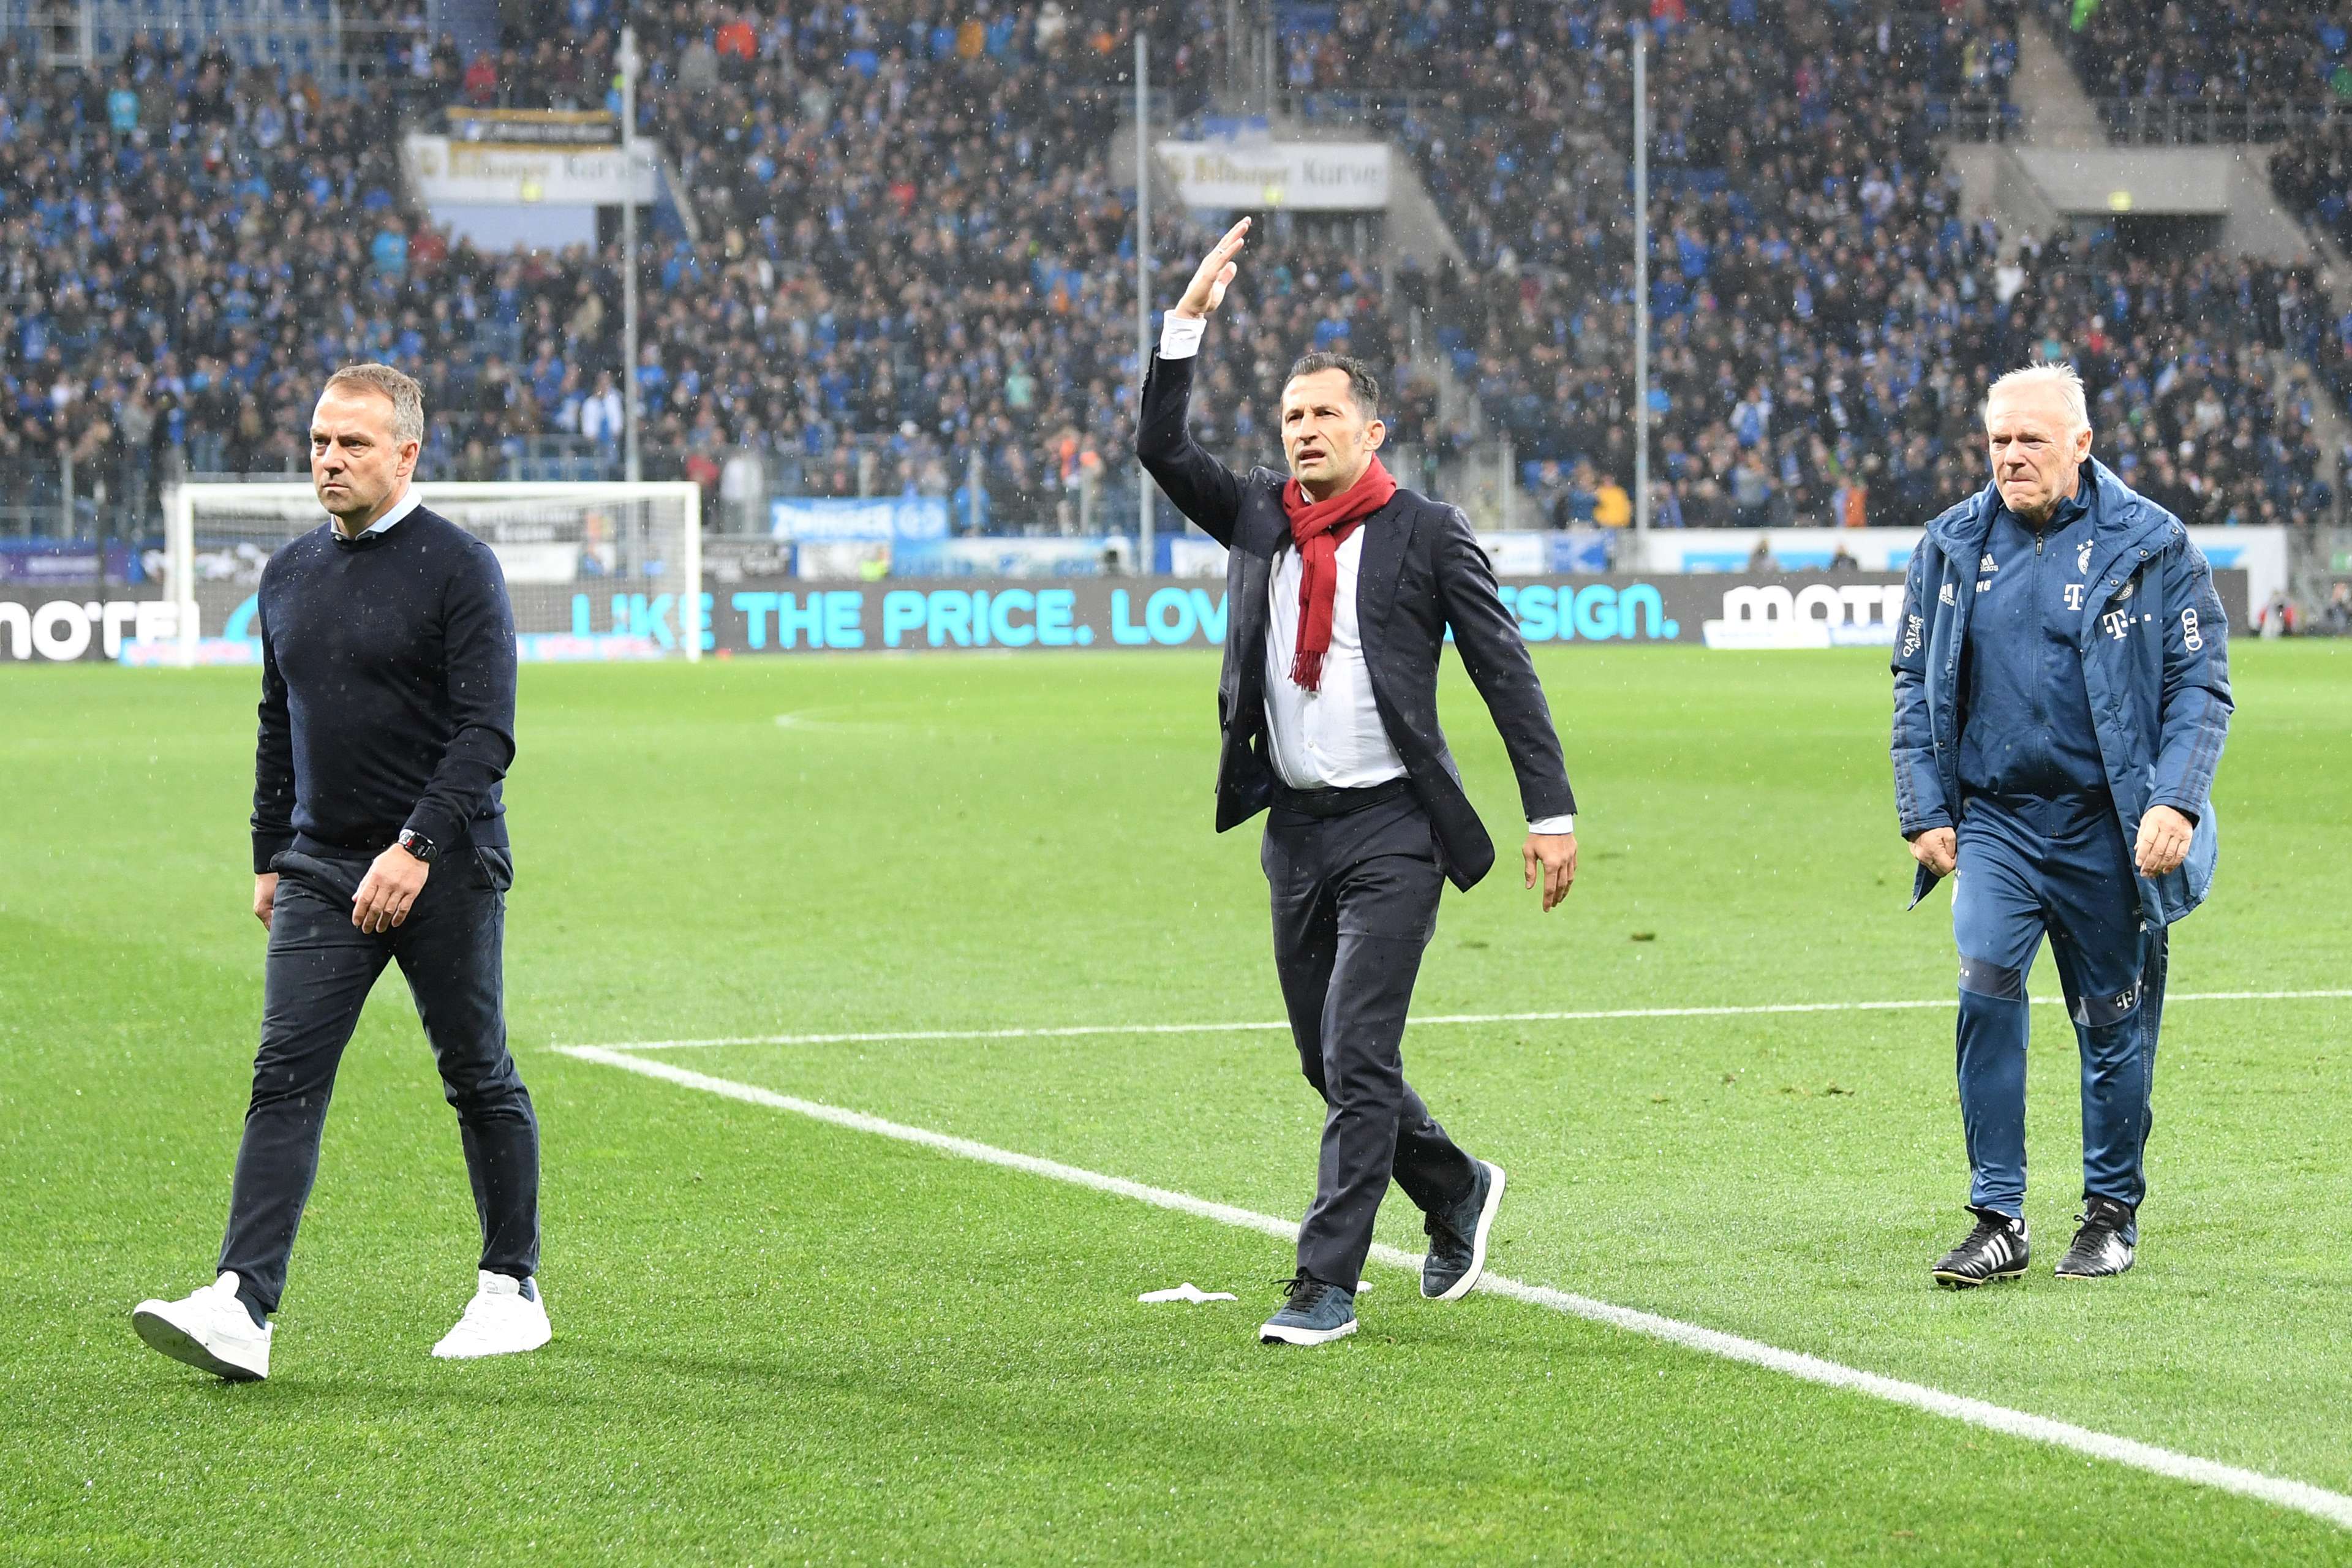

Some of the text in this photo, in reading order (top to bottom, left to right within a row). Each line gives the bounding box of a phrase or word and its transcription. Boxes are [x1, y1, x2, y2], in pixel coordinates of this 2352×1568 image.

[1976, 580, 1992, 592] HG
[732, 589, 864, 648] THE
[883, 588, 1093, 647] PRICE.
[1111, 587, 1227, 645] LOV
[1903, 614, 1917, 657] QATAR
[2139, 921, 2147, 932] H
